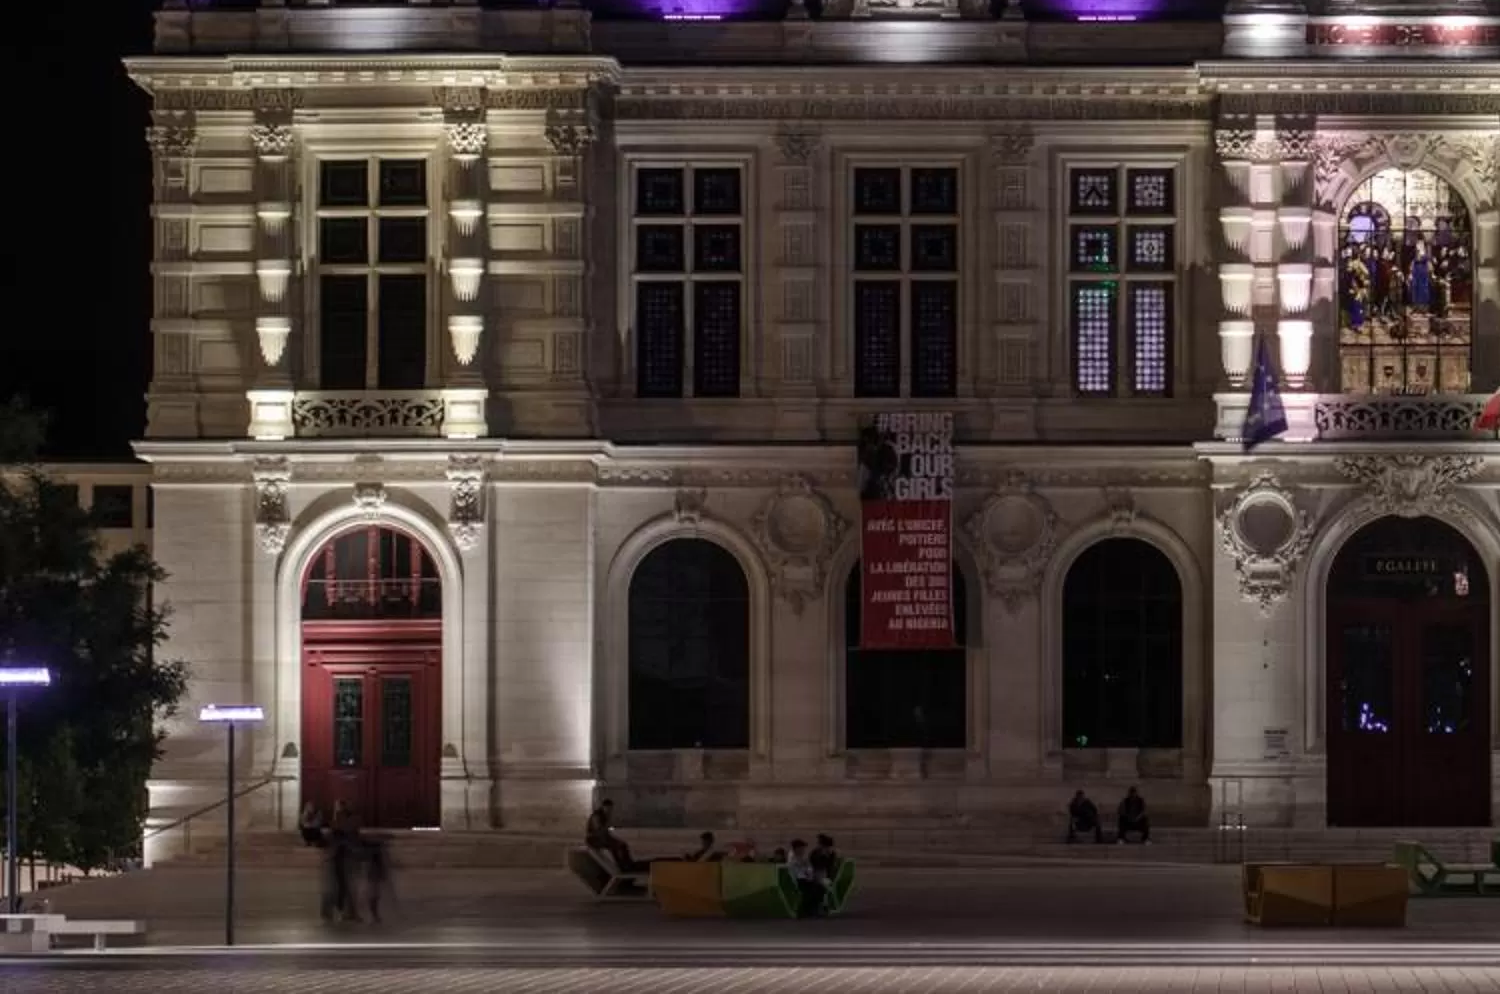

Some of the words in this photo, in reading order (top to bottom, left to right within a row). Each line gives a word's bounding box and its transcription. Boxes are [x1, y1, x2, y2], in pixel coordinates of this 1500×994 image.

[873, 413, 953, 433] #BRING
[896, 433, 953, 454] BACK
[911, 454, 953, 477] OUR
[895, 477, 953, 500] GIRLS
[899, 533, 947, 546] POITIERS
[918, 547, 947, 559] POUR
[869, 561, 883, 574] LA
[885, 558, 947, 574] LIBÉRATION
[905, 575, 926, 588] DES
[870, 589, 912, 603] JEUNES
[913, 589, 948, 602] FILLES
[888, 617, 904, 630] AU
